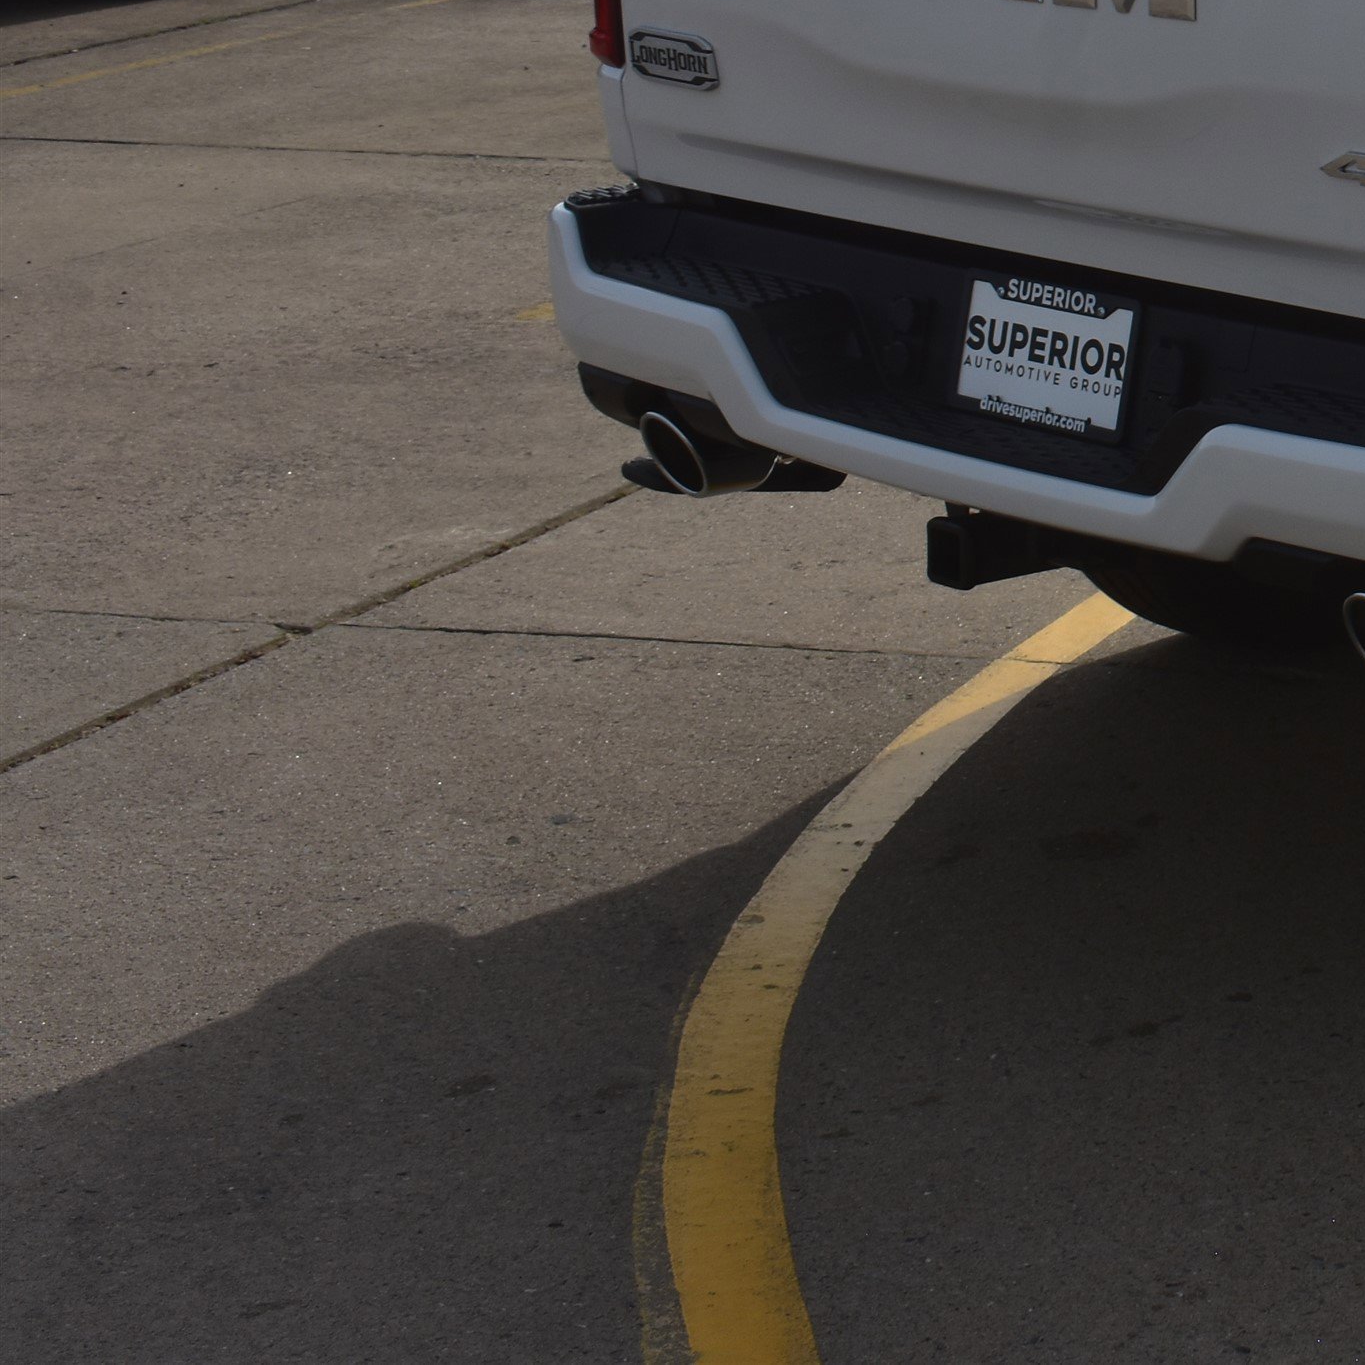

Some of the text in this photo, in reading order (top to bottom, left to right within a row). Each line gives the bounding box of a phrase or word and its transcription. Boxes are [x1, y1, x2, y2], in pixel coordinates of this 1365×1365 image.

[1007, 278, 1096, 314] SUPERIOR
[966, 315, 1126, 381] SUPERIOR
[963, 354, 1122, 398] AUTOMOTIVE GROUP
[979, 394, 1086, 433] drivesuperior.com
